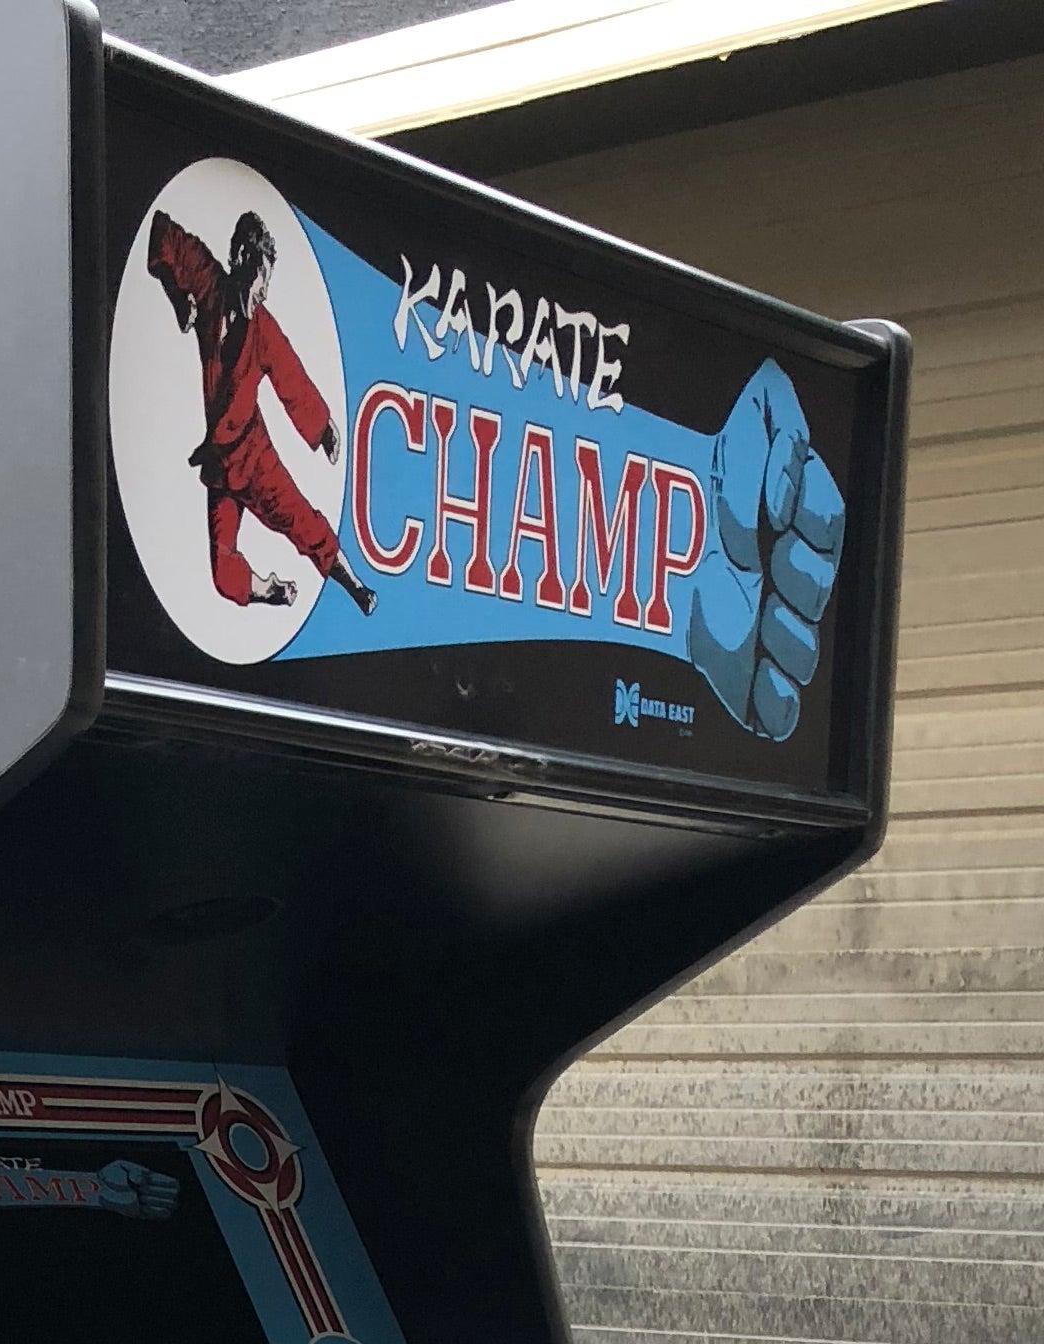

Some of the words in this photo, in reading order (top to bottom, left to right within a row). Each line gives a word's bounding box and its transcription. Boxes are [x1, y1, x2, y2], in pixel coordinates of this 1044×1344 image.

[393, 253, 631, 415] KARATE
[353, 380, 708, 637] CHAMP
[640, 697, 667, 719] DATA
[668, 702, 695, 724] EAST
